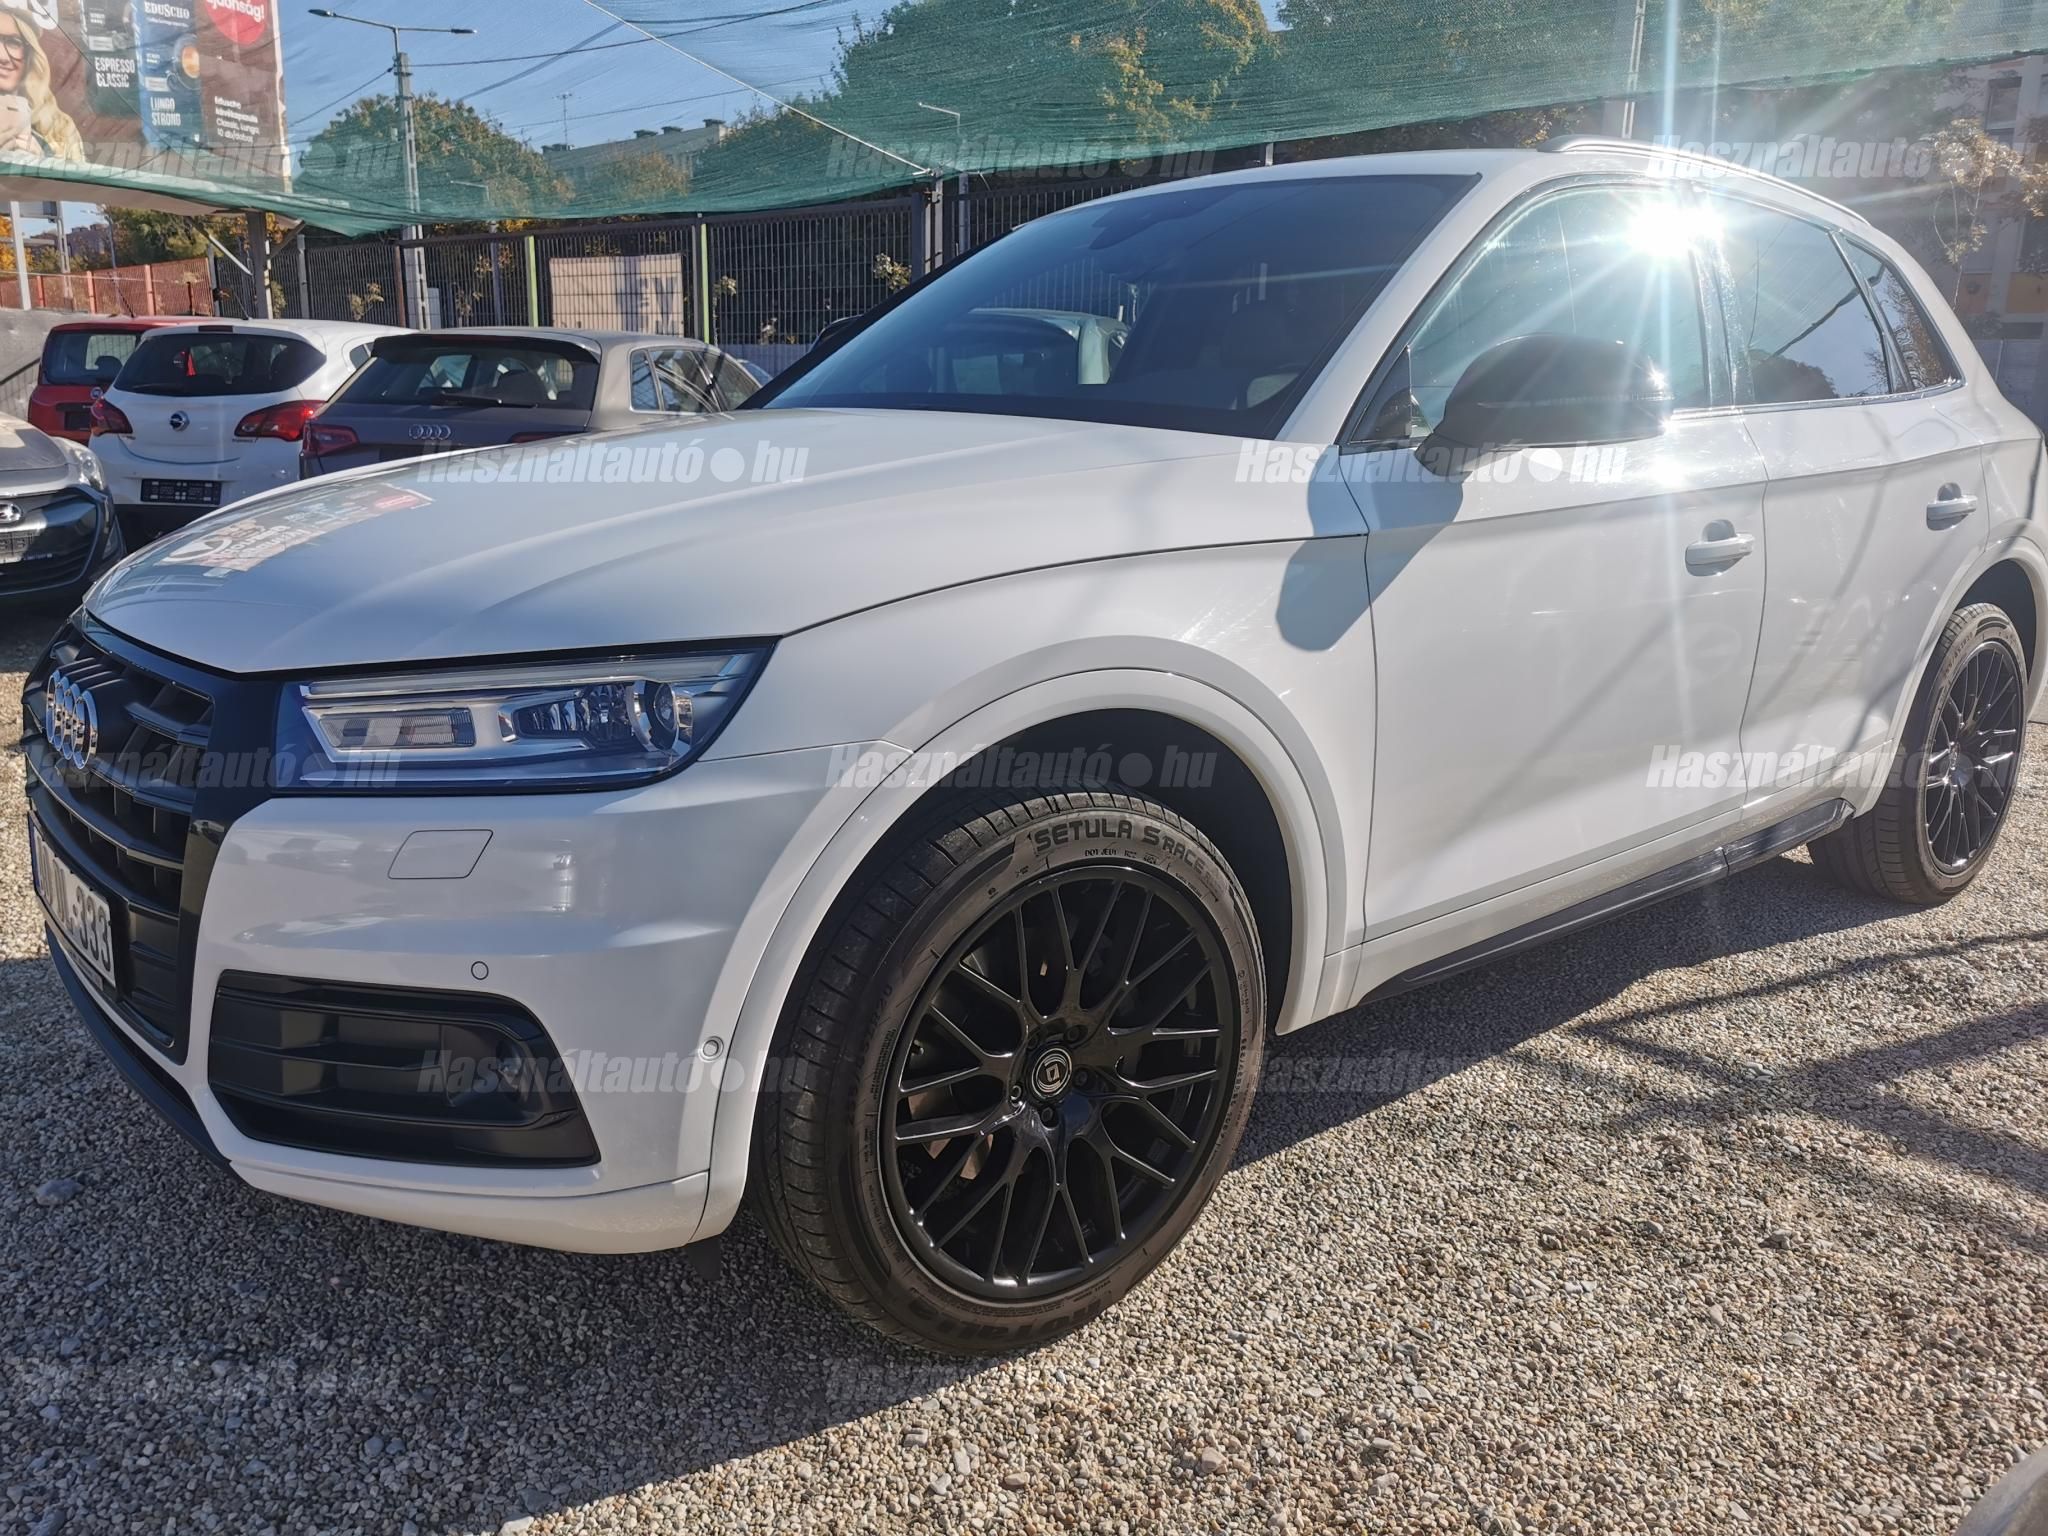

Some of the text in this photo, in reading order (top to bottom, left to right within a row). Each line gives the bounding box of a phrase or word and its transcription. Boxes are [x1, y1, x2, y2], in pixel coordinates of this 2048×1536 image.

[144, 1, 190, 20] EDUSCHO
[206, 0, 264, 22] onság!
[94, 56, 135, 74] ESPRESSO
[95, 72, 130, 88] CLASSIC
[150, 96, 176, 111] LUNGO
[151, 112, 181, 127] STRONG
[1034, 818, 1133, 852] SETULA
